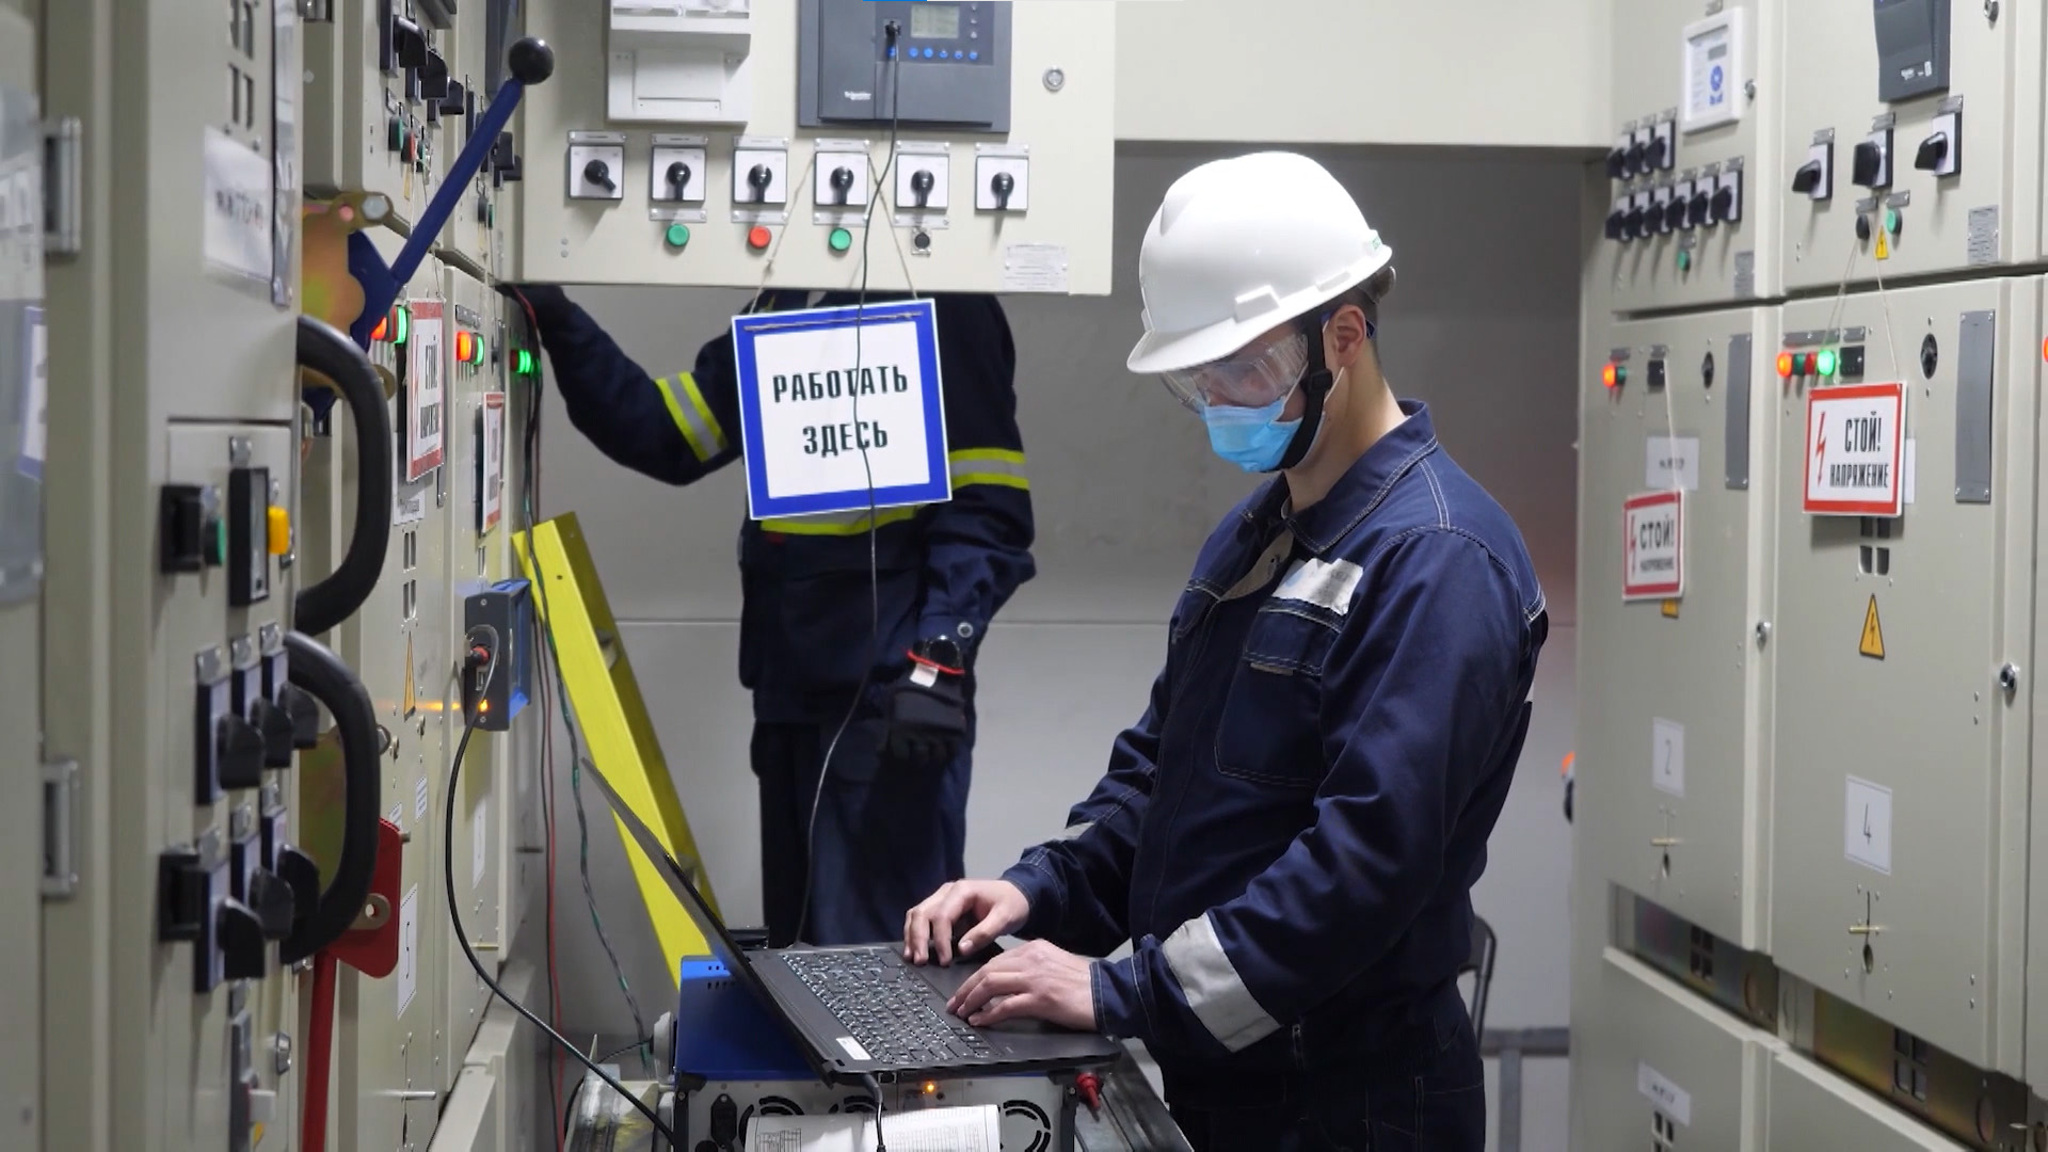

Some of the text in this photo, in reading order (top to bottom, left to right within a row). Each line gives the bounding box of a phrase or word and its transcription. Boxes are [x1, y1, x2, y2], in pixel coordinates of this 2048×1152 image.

[772, 364, 908, 403] РАБОТАТЬ
[802, 421, 889, 458] ЗДЕСЬ
[1844, 411, 1882, 453] СТОЙ!
[1829, 463, 1889, 488] НАПРЯЖЕНИЕ
[1639, 514, 1675, 550] СТОЙ!
[1863, 802, 1872, 845] 4
